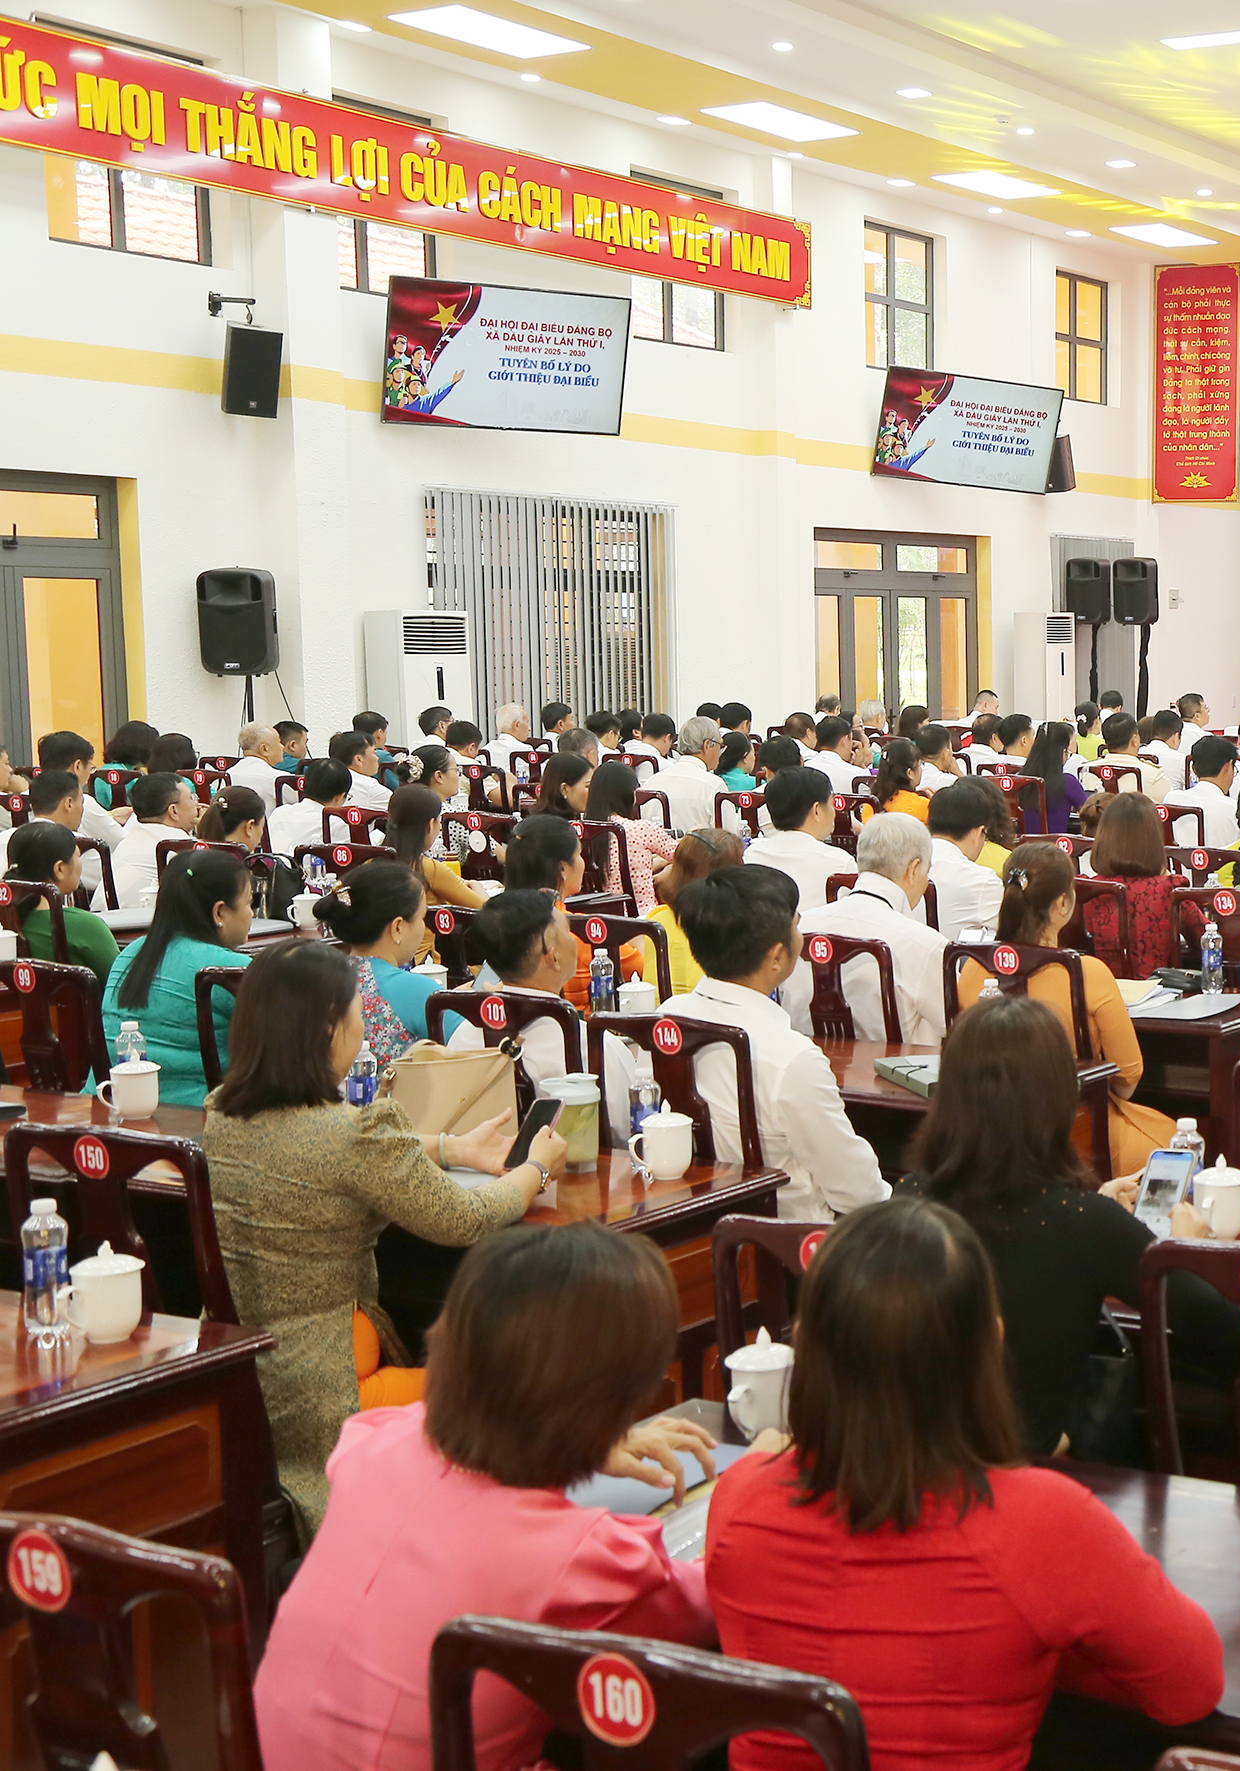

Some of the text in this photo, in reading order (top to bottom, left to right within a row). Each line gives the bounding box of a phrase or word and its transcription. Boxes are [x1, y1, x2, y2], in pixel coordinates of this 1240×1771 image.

[75, 72, 166, 152] MỌI
[179, 91, 318, 179] THẮNG
[330, 134, 390, 202] LỢI
[400, 140, 470, 213] CỦA
[478, 165, 562, 233] CÁCH
[573, 192, 661, 255] MẠNG
[667, 212, 725, 273] VIỆT
[731, 230, 791, 282] NAM
[742, 796, 749, 804] 73
[337, 850, 347, 861] 86
[1194, 853, 1203, 865] 83
[1217, 897, 1233, 910] 134
[440, 914, 449, 928] 93
[591, 923, 601, 938] 94
[815, 942, 827, 957] 95
[998, 952, 1015, 968] 139
[19, 969, 30, 986] 99
[657, 1027, 678, 1046] 144
[78, 1144, 104, 1171] 150
[17, 1547, 62, 1596] 159
[588, 1672, 643, 1727] 160
